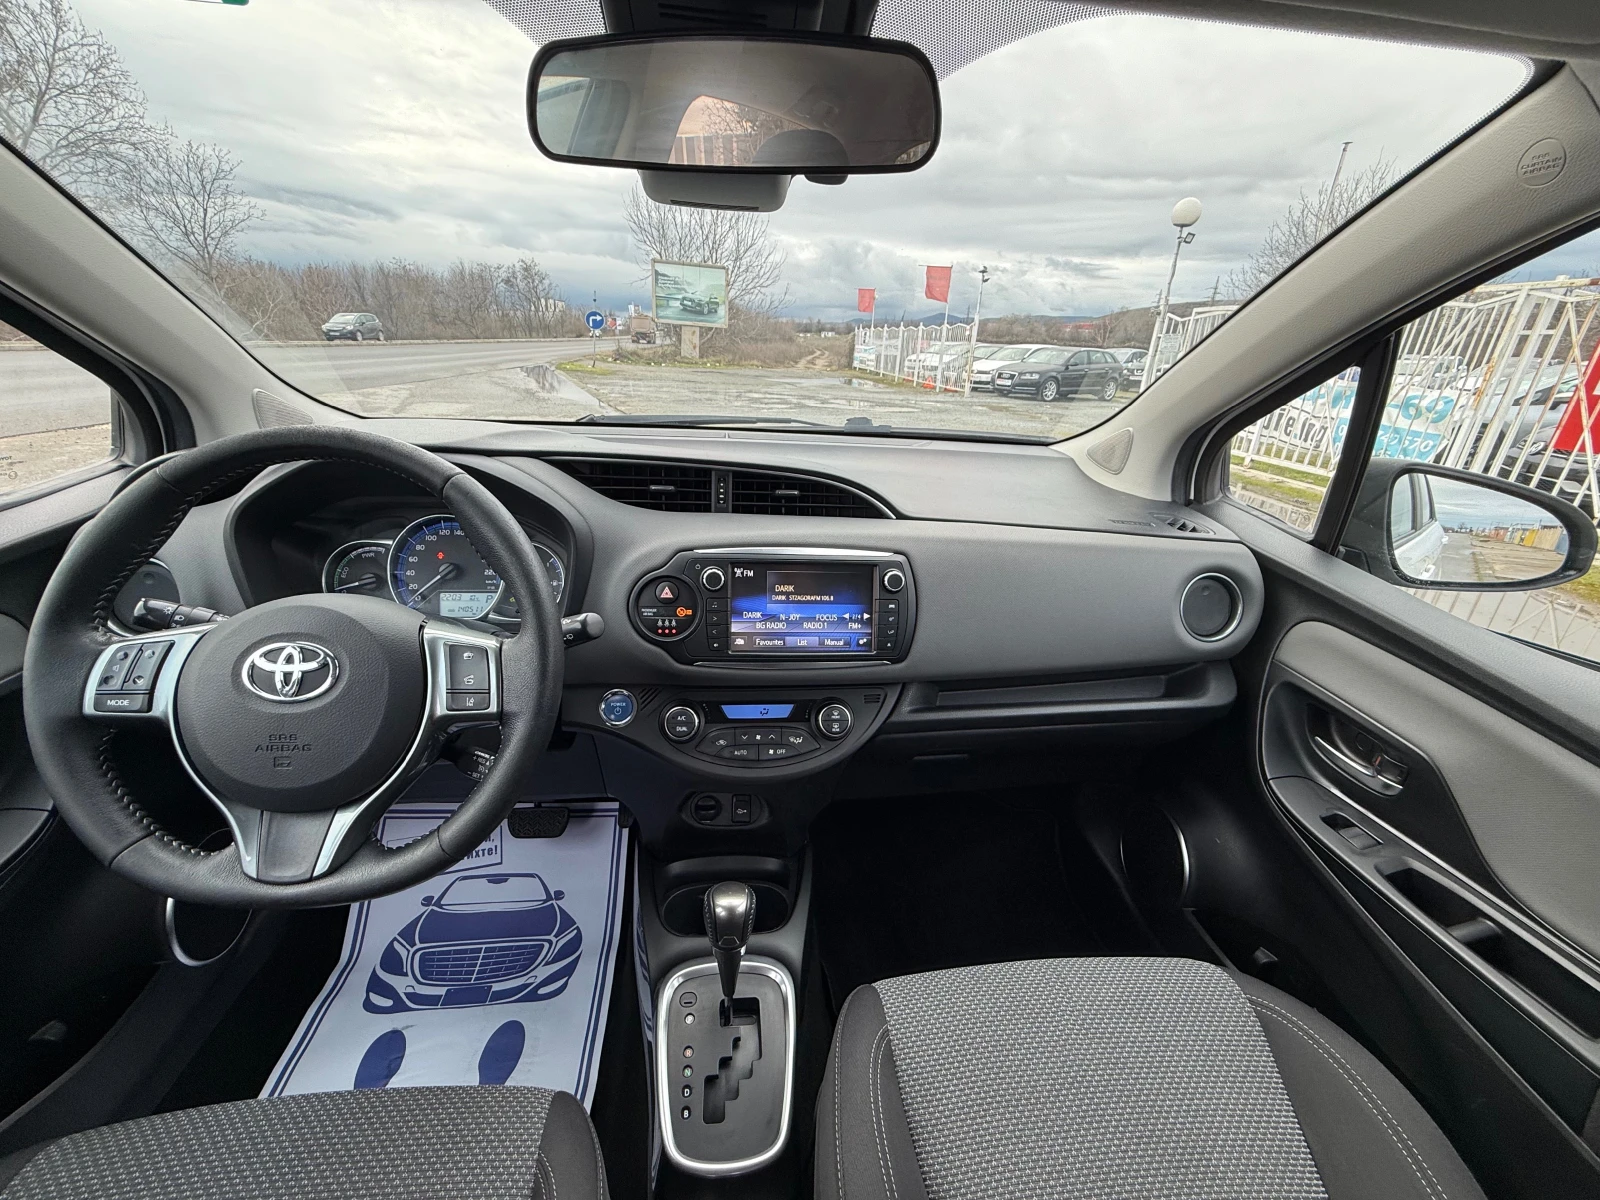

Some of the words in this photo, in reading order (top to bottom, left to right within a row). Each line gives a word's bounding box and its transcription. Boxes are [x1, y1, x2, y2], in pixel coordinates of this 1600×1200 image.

[341, 566, 349, 579] ECO
[775, 584, 795, 592] DARIK
[485, 594, 494, 604] P
[268, 733, 297, 741] SRS
[254, 743, 312, 752] AIRBAG
[685, 1049, 692, 1057] R
[684, 1068, 691, 1076] N
[683, 1088, 690, 1097] D
[683, 1109, 690, 1118] B
